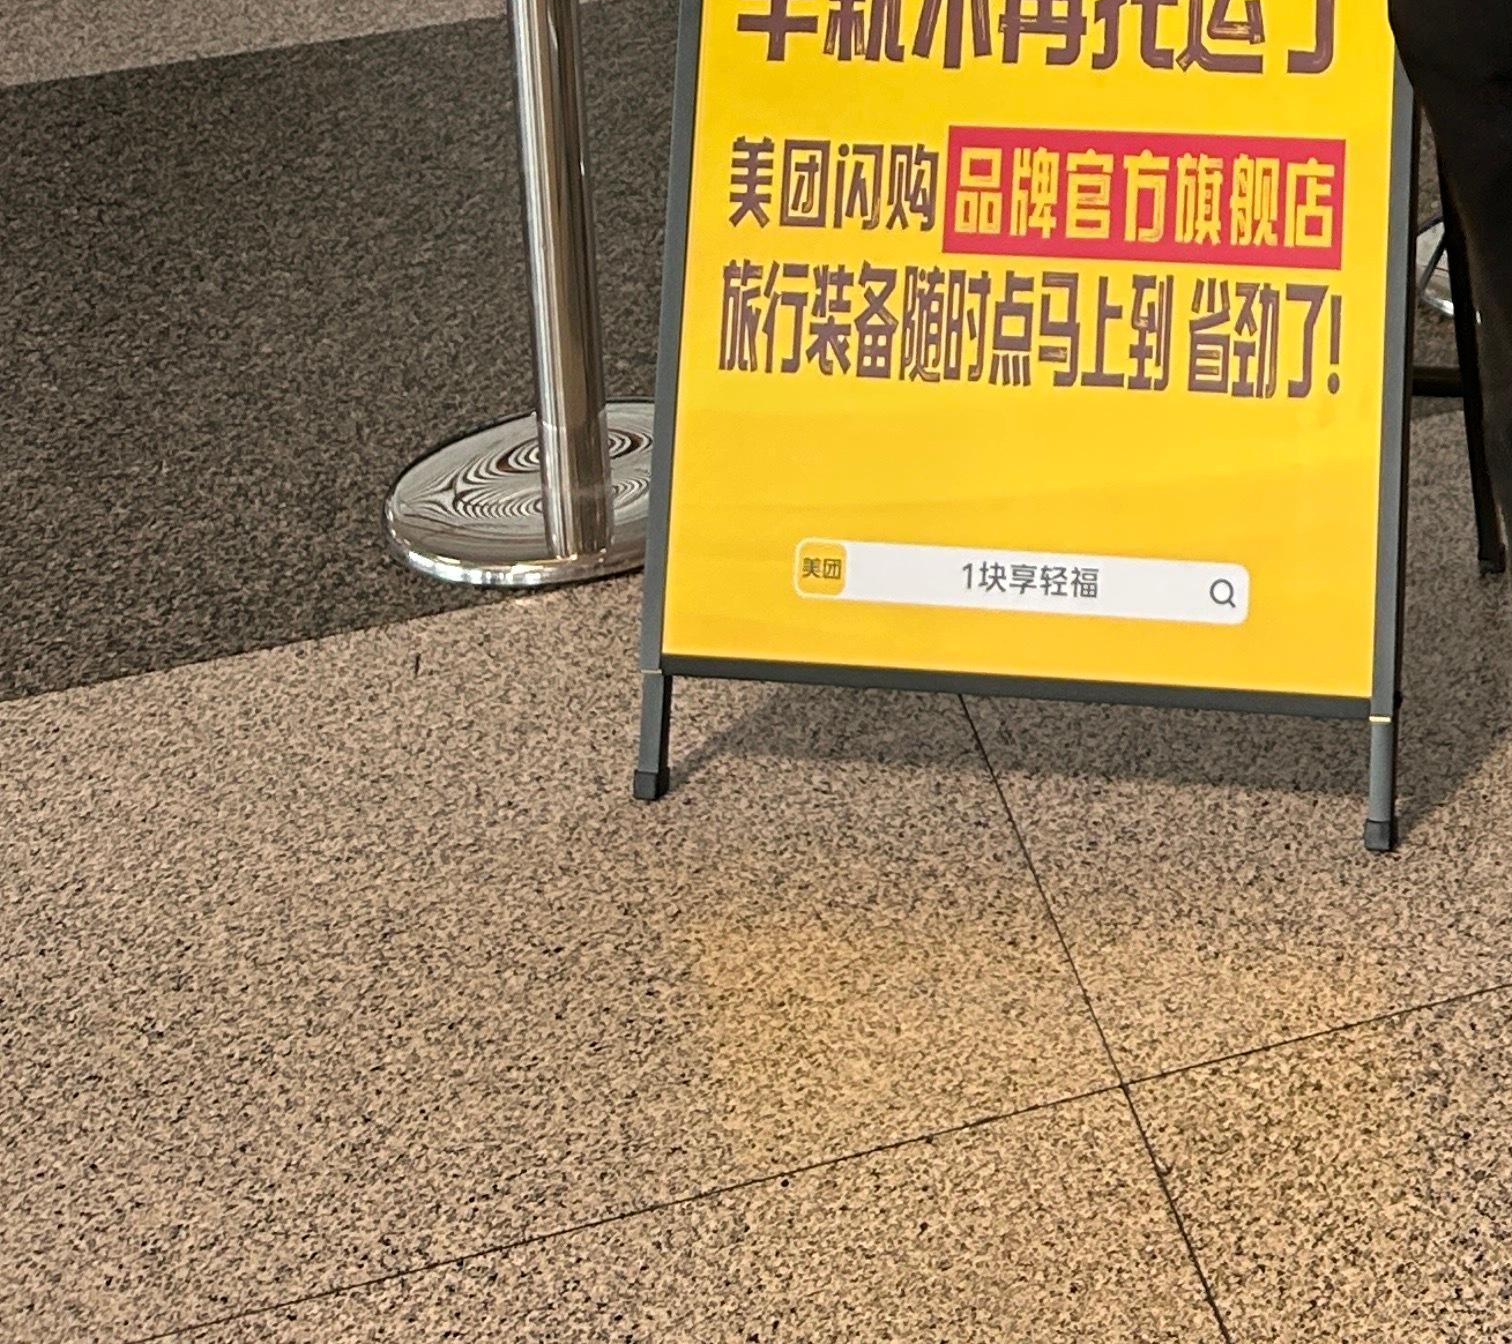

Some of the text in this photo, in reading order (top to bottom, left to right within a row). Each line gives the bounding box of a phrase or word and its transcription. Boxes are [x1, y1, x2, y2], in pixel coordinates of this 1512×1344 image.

[728, 135, 1336, 252] 美团闪购 品牌官方旗舰店
[717, 259, 1344, 402] 旅行装备随时点马上到 省劲了!
[800, 555, 844, 583] 美团
[960, 558, 1100, 603] 1块享轻福
